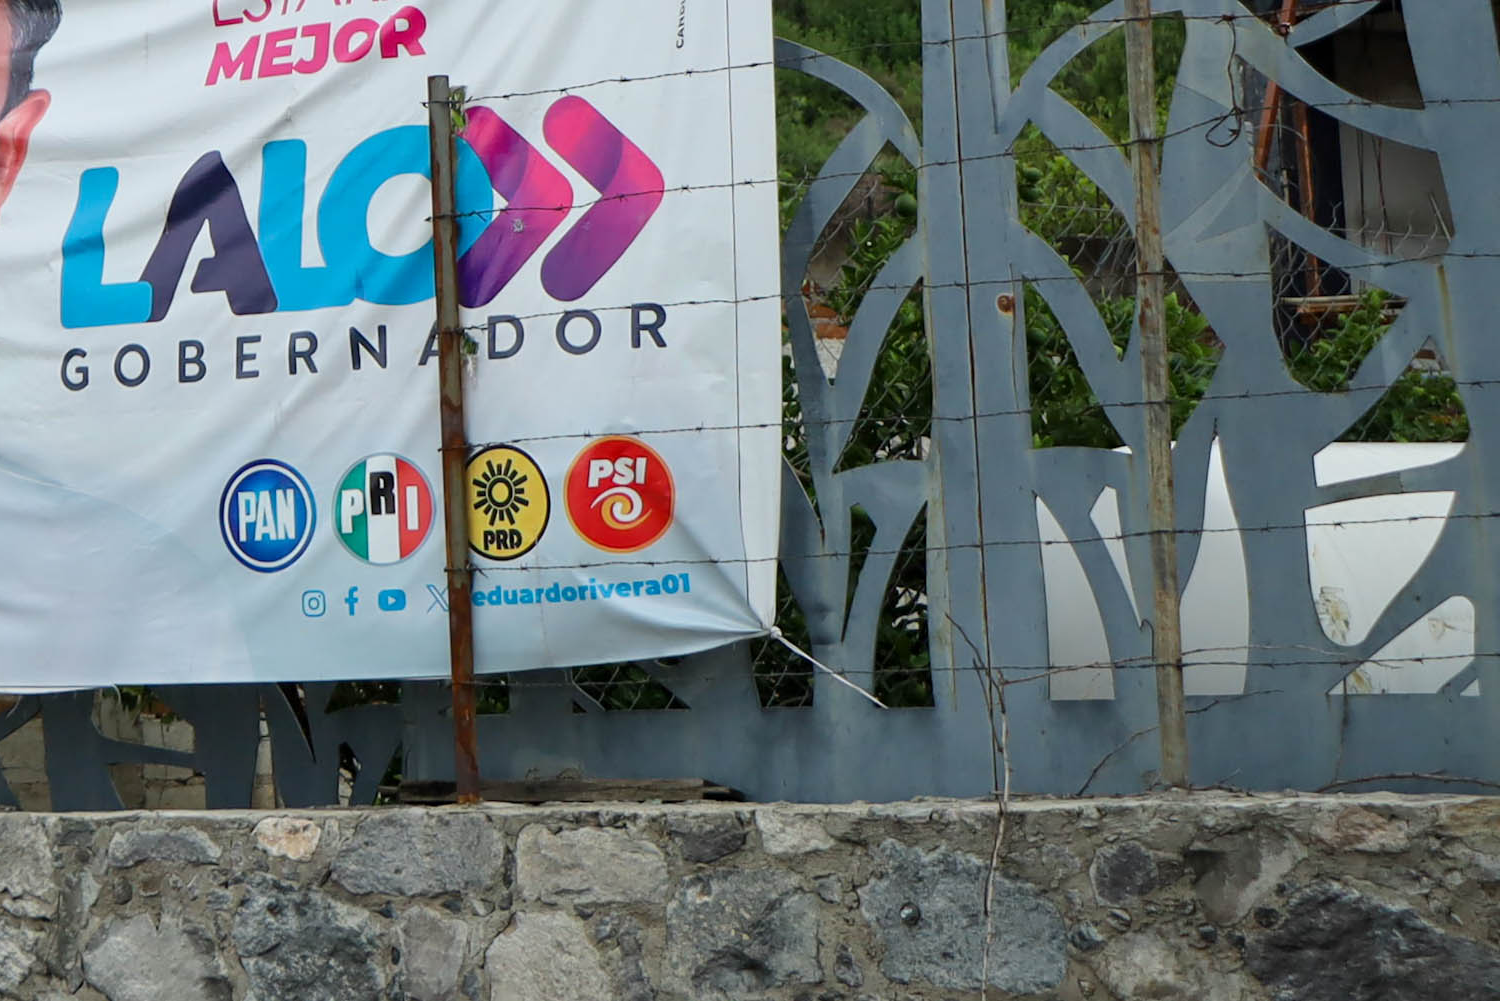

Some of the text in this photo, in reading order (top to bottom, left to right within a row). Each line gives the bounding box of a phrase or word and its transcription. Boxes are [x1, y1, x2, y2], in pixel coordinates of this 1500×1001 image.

[204, 5, 428, 86] MEJOR
[59, 124, 494, 329] LALO
[587, 456, 647, 489] PSI
[237, 487, 296, 543] PAN
[340, 471, 420, 534] PRI
[483, 527, 523, 552] PRD
[472, 571, 691, 607] eduardorivera01
